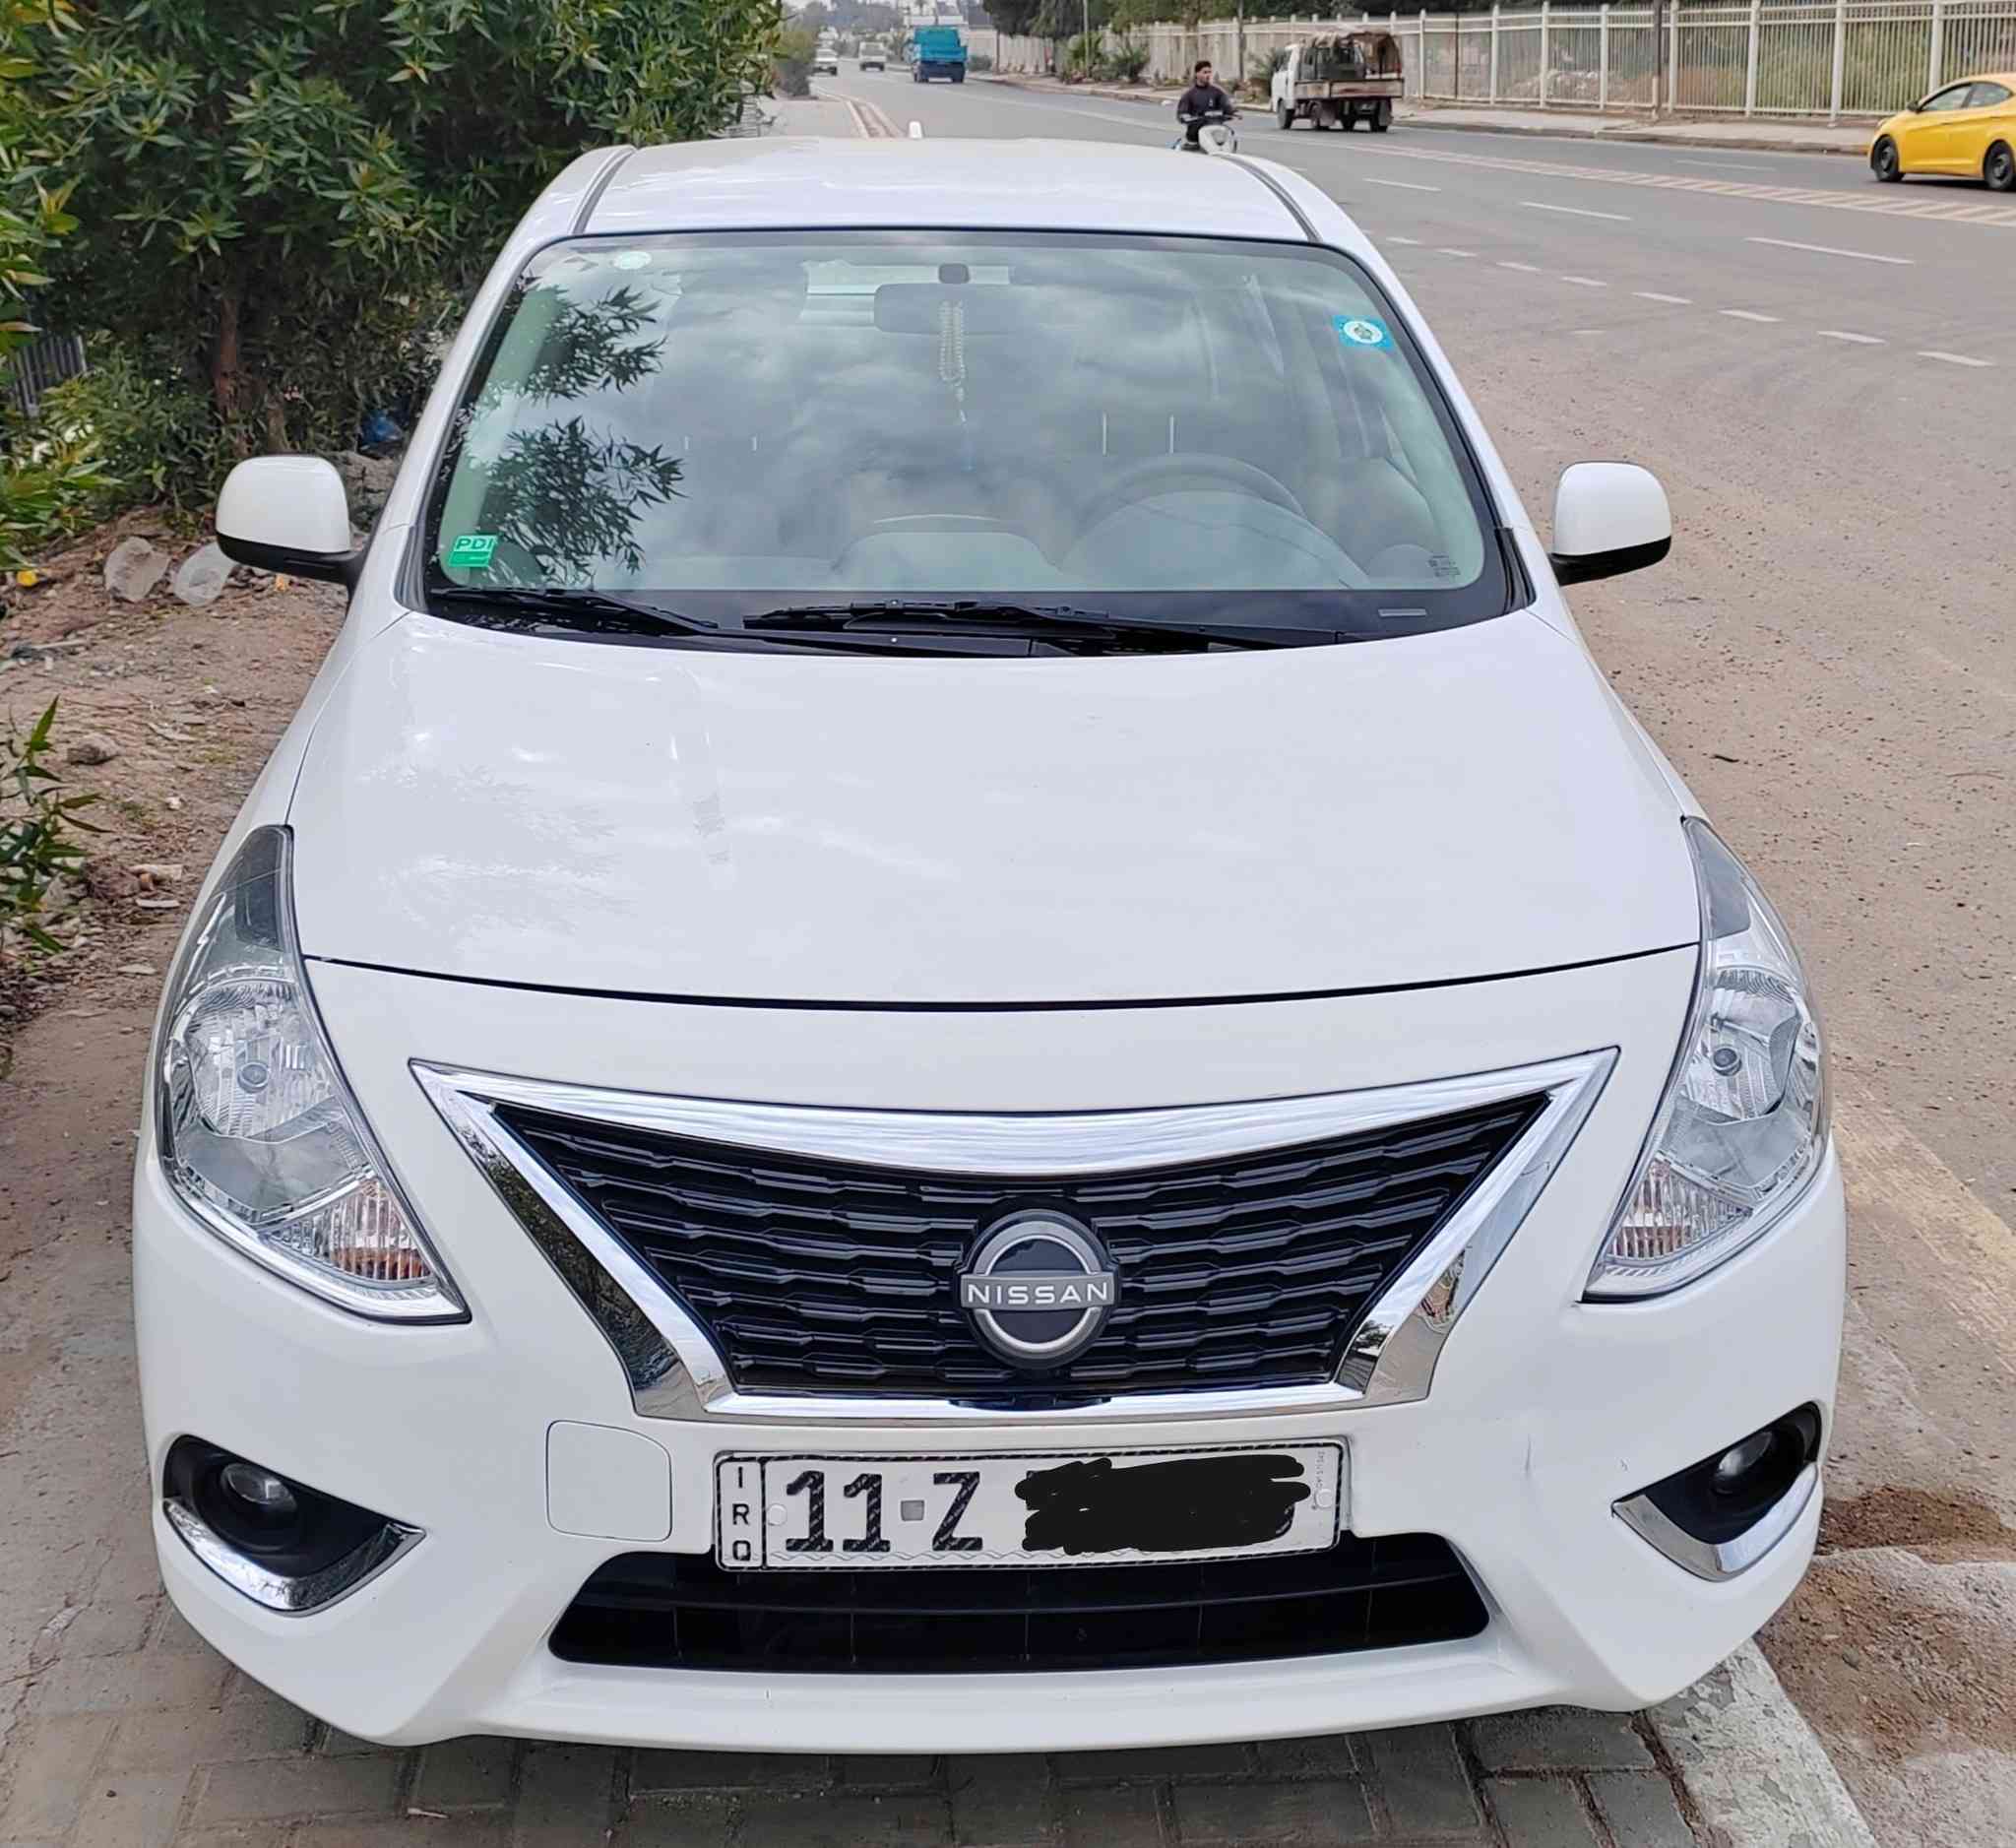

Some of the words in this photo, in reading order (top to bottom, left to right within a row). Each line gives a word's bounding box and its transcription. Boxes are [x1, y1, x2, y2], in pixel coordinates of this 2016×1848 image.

[456, 538, 493, 549] PDI
[968, 1282, 1107, 1305] NISSAN
[731, 1466, 752, 1561] IRQ
[786, 1470, 891, 1553] 11
[932, 1471, 983, 1552] Z
